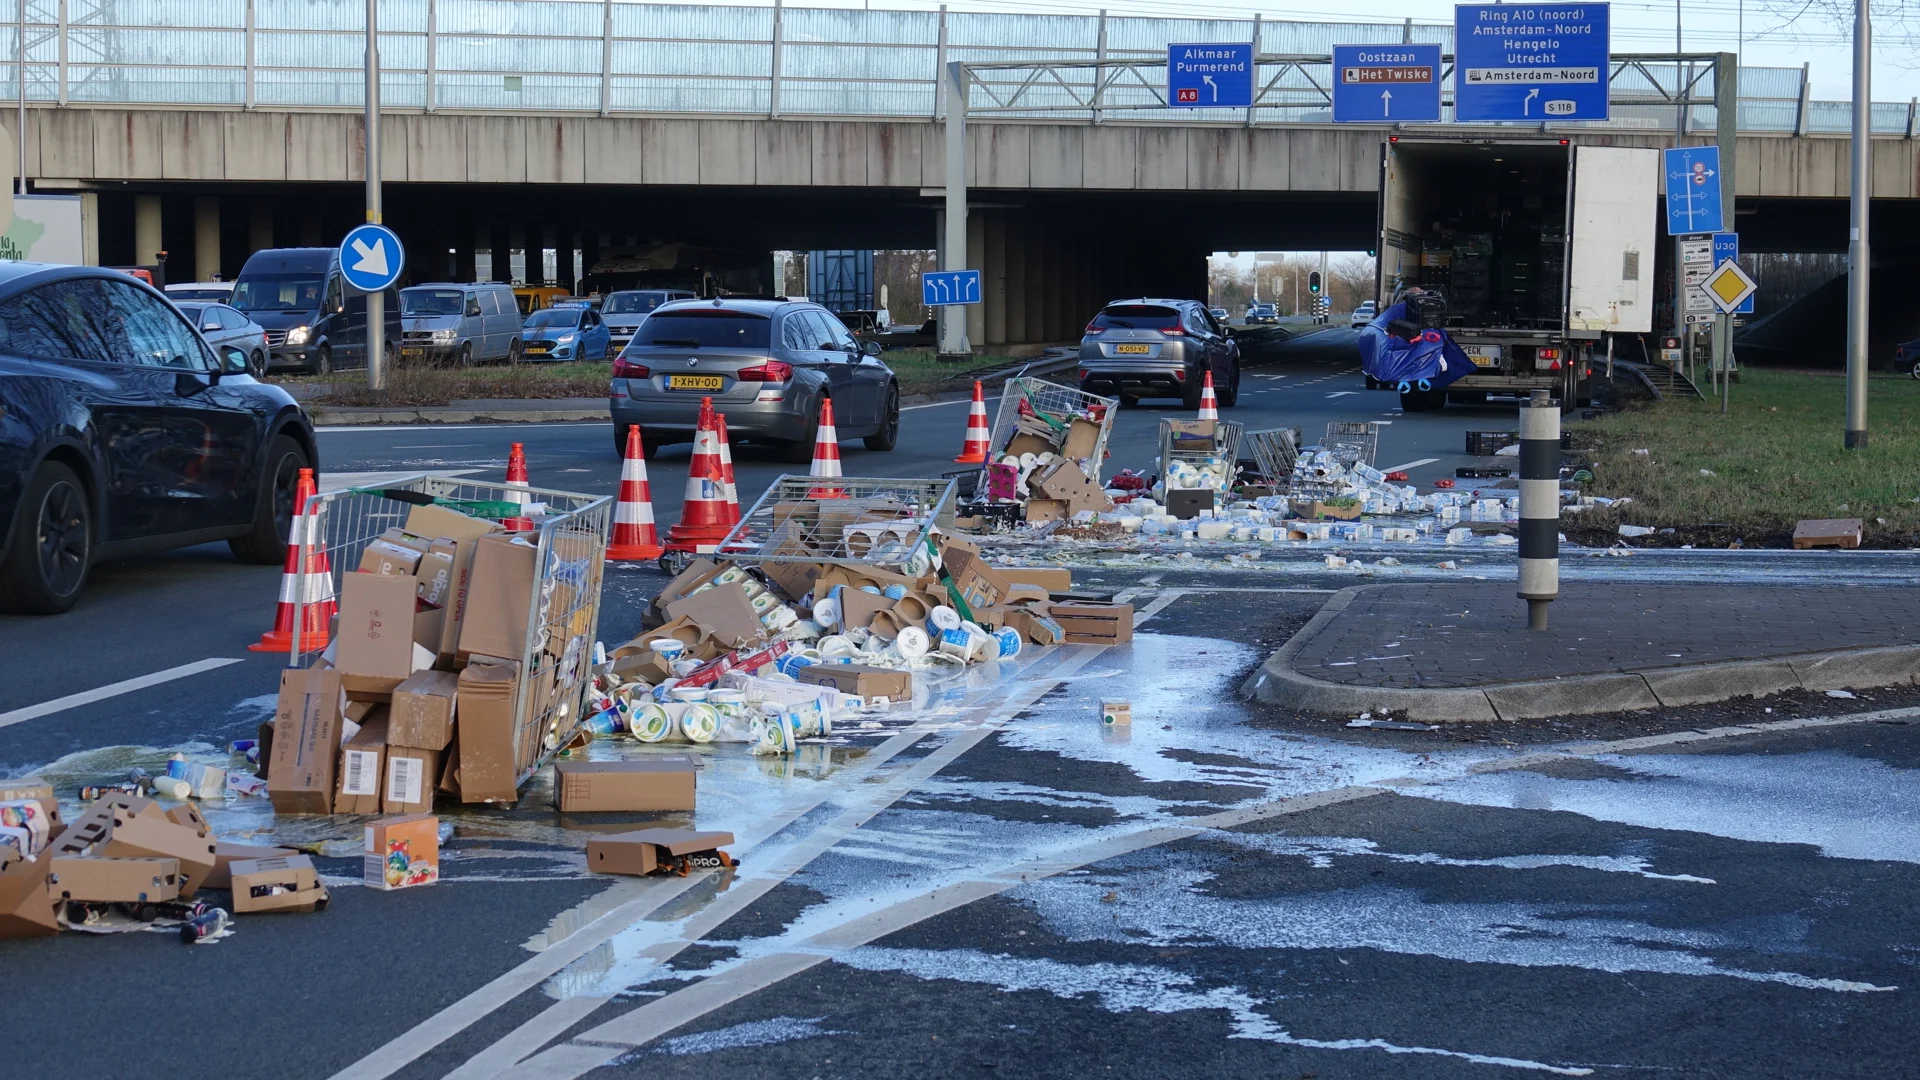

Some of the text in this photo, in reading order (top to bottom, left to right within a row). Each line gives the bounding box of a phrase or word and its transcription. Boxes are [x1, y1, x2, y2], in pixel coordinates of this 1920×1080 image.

[1480, 8, 1585, 23] Ring A10 (noord)
[1473, 24, 1591, 35] Amsterdam-Noord
[1504, 39, 1560, 52] Hengelo
[1184, 48, 1237, 59] Alkmaar
[1358, 52, 1415, 62] Oostzaan
[1507, 53, 1556, 63] Utrecht
[1177, 62, 1245, 72] Purmerend
[1361, 69, 1429, 79] Het Twiske
[1485, 69, 1595, 81] Amsterdam-Noord
[1715, 242, 1736, 250] U30
[673, 377, 718, 387] 1-XHV-00
[429, 568, 449, 602] alpro
[454, 567, 468, 622] SIDE TO OPEN
